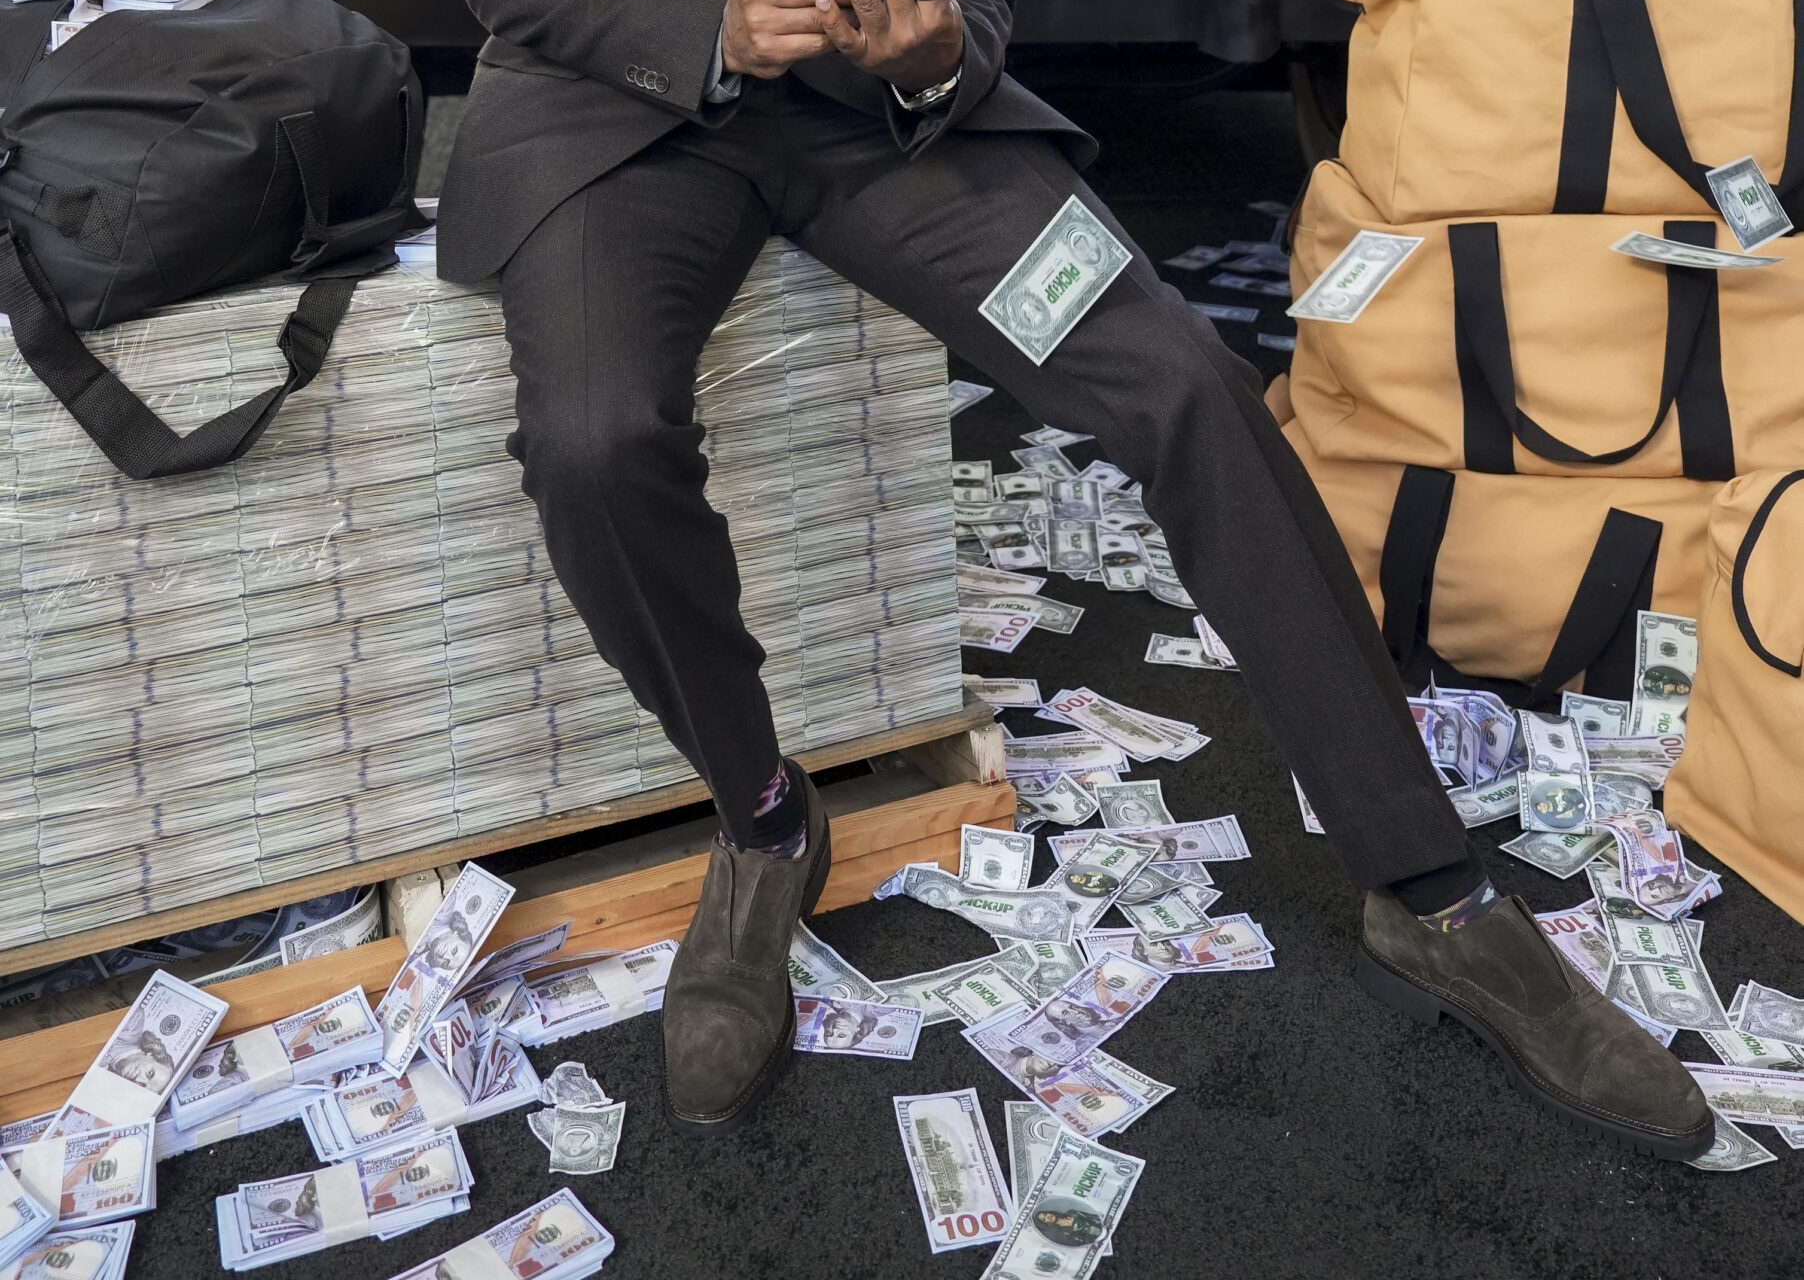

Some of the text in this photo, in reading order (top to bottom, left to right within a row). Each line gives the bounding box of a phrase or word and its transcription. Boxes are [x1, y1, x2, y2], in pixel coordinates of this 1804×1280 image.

[1044, 263, 1081, 305] PICKUP
[994, 616, 1029, 645] 100
[1054, 693, 1095, 714] 100
[1478, 784, 1517, 804] PICKUP
[1100, 848, 1127, 868] PICKUP
[958, 898, 1014, 913] PICKUP
[1150, 904, 1181, 930] PICKUP
[1637, 925, 1658, 955] PICKUP
[966, 980, 1002, 1008] PICKUP
[343, 1086, 379, 1101] 100
[1061, 1112, 1089, 1134] 100
[417, 1183, 454, 1199] 100
[1072, 1160, 1104, 1199] PICKUP
[95, 1192, 134, 1210] 100
[995, 1197, 1036, 1266] PROMOTIONAL
[1042, 1154, 1059, 1178] ONLY
[937, 1210, 1005, 1241] 100
[560, 1236, 596, 1259] 100
